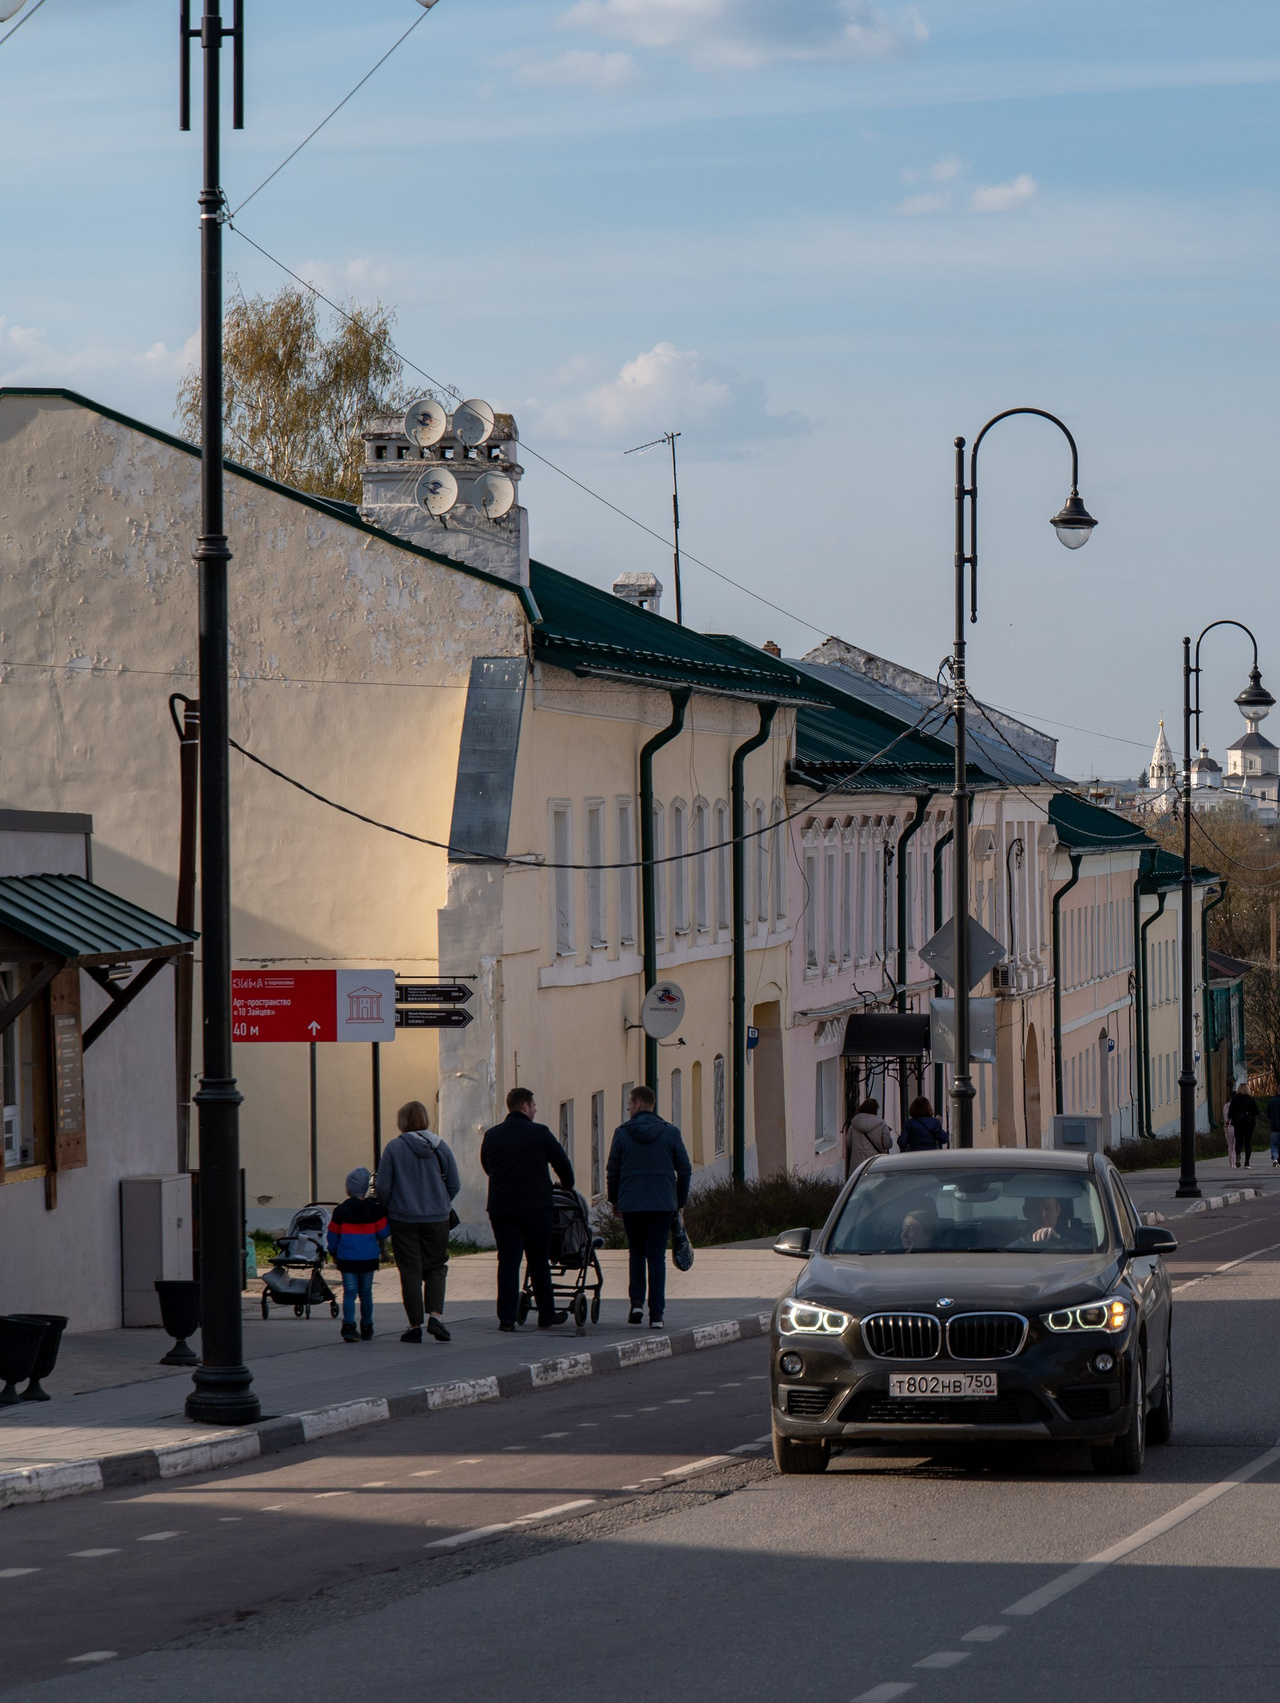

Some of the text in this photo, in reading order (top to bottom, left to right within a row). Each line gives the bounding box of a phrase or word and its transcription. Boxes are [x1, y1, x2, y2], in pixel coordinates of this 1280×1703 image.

[232, 998, 291, 1007] Арт-пространство
[247, 1007, 275, 1017] Зайцев»
[233, 1022, 259, 1036] 40 м
[966, 1375, 992, 1388] 750
